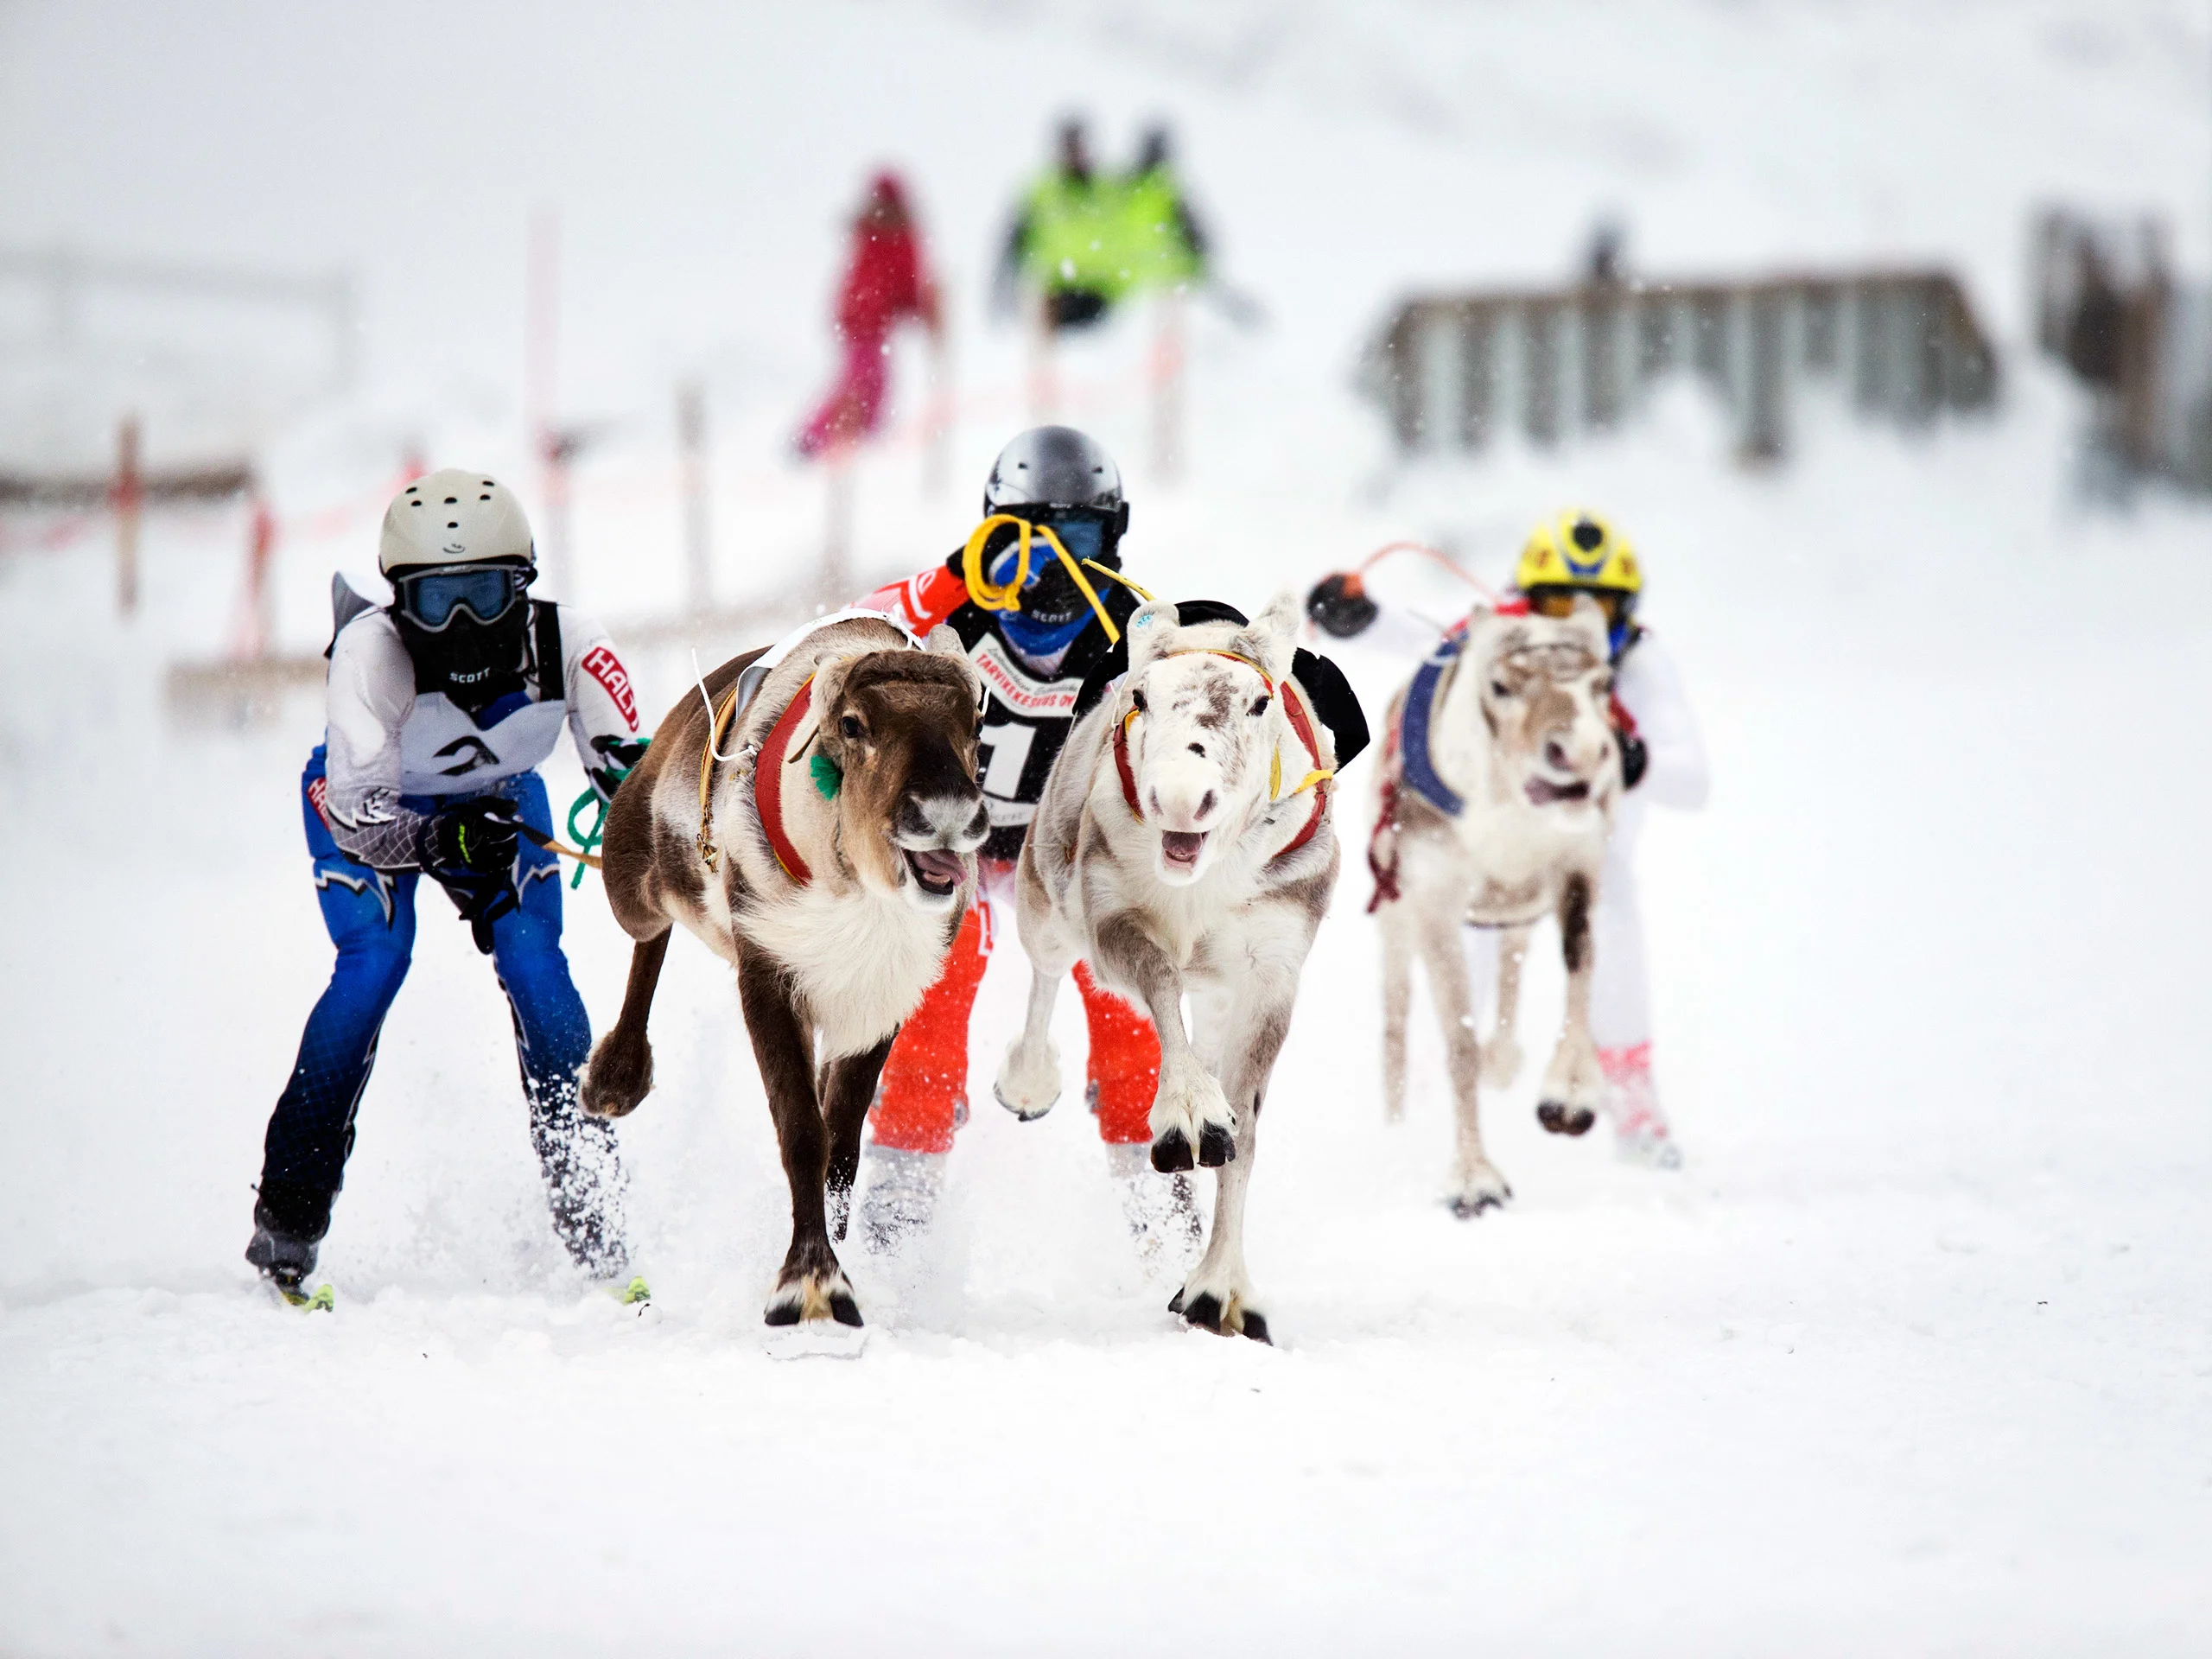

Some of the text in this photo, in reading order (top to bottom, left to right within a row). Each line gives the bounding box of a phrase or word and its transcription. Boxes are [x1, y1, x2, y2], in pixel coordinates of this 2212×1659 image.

[1032, 609, 1072, 623] SCOTT
[449, 666, 490, 683] SCOTT
[978, 721, 1037, 798] 1
